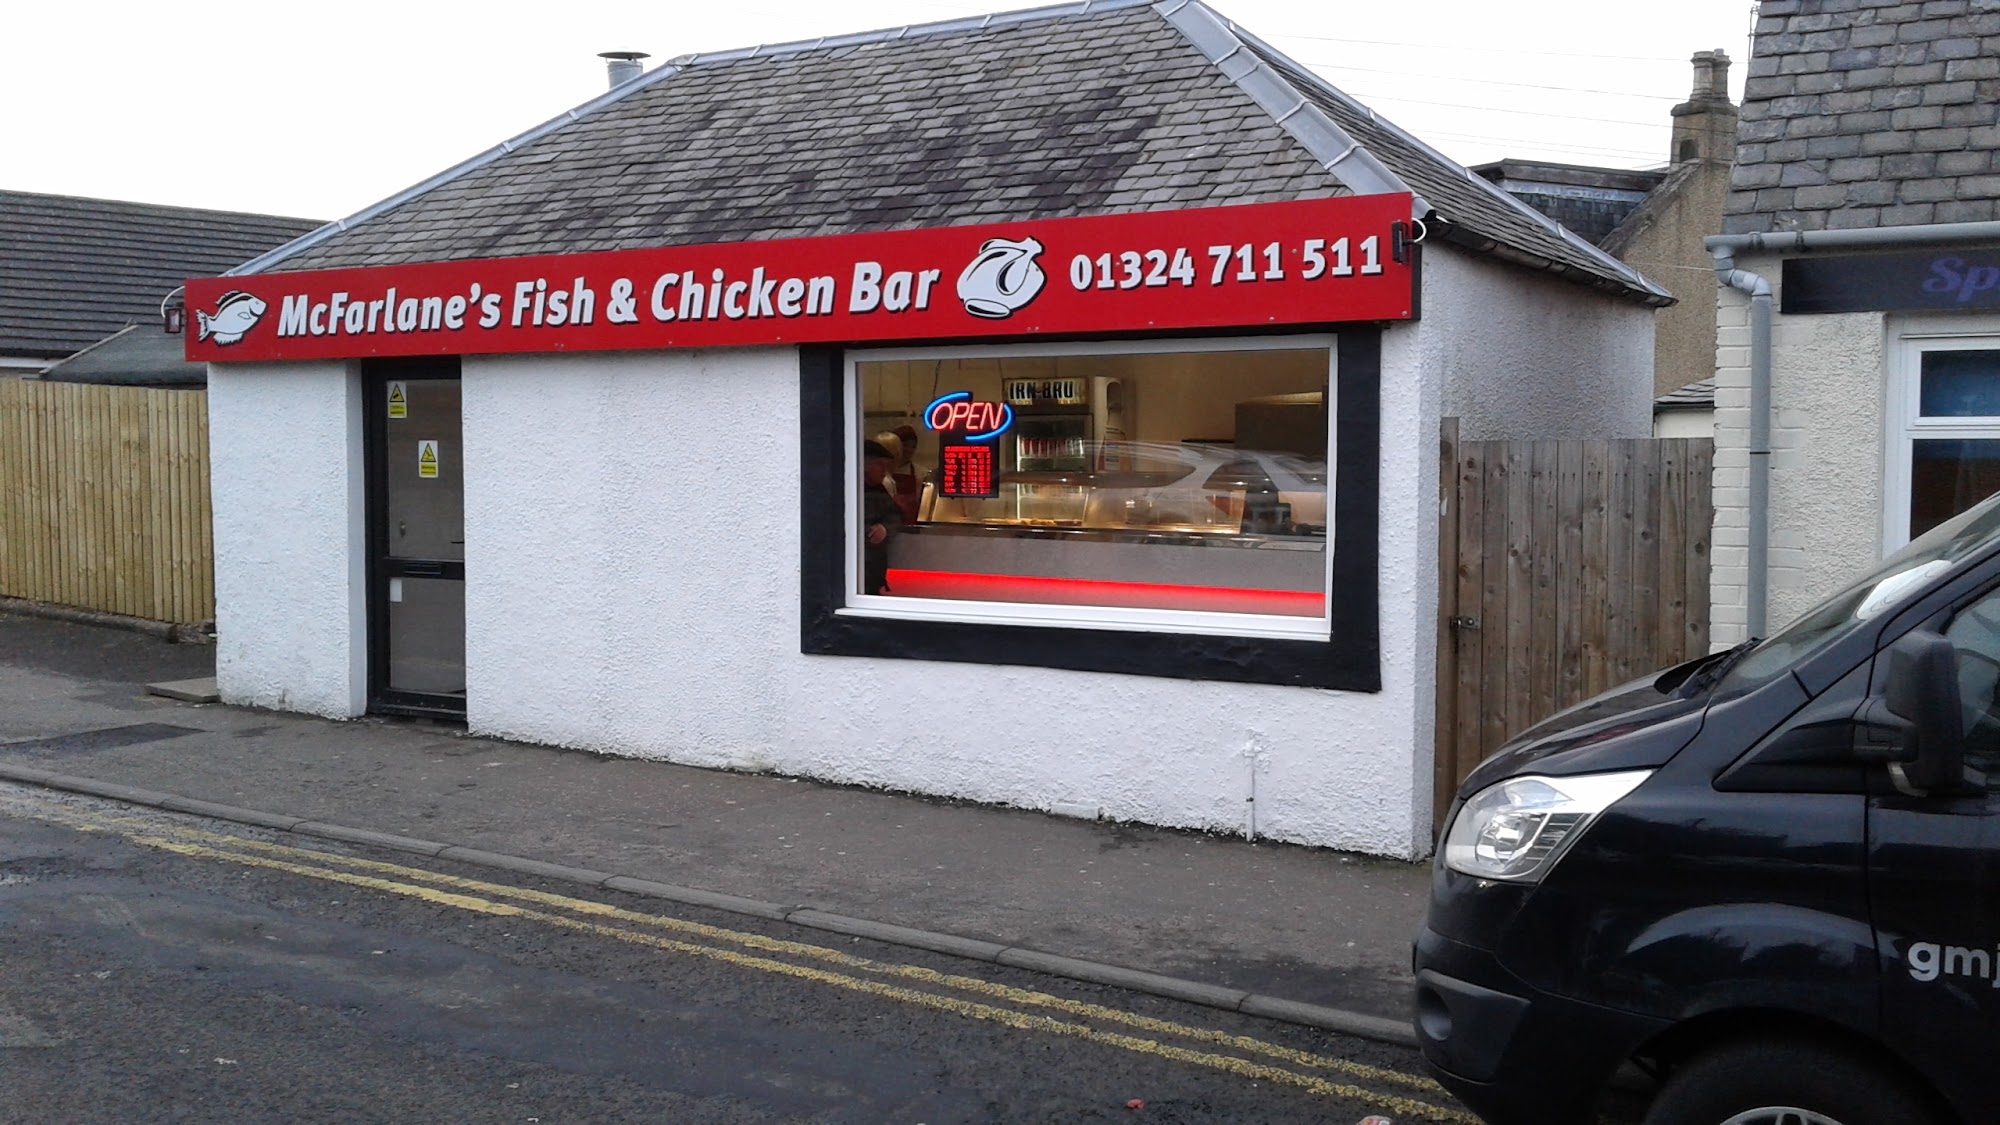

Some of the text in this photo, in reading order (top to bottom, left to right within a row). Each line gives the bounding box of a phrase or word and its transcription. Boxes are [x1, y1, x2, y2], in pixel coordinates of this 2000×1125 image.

[1069, 235, 1383, 291] 01324 711 511
[277, 261, 942, 337] McFarlane's Fish & Chicken Bar
[1009, 380, 1074, 400] IRN-BRU
[931, 402, 1004, 430] OPEN
